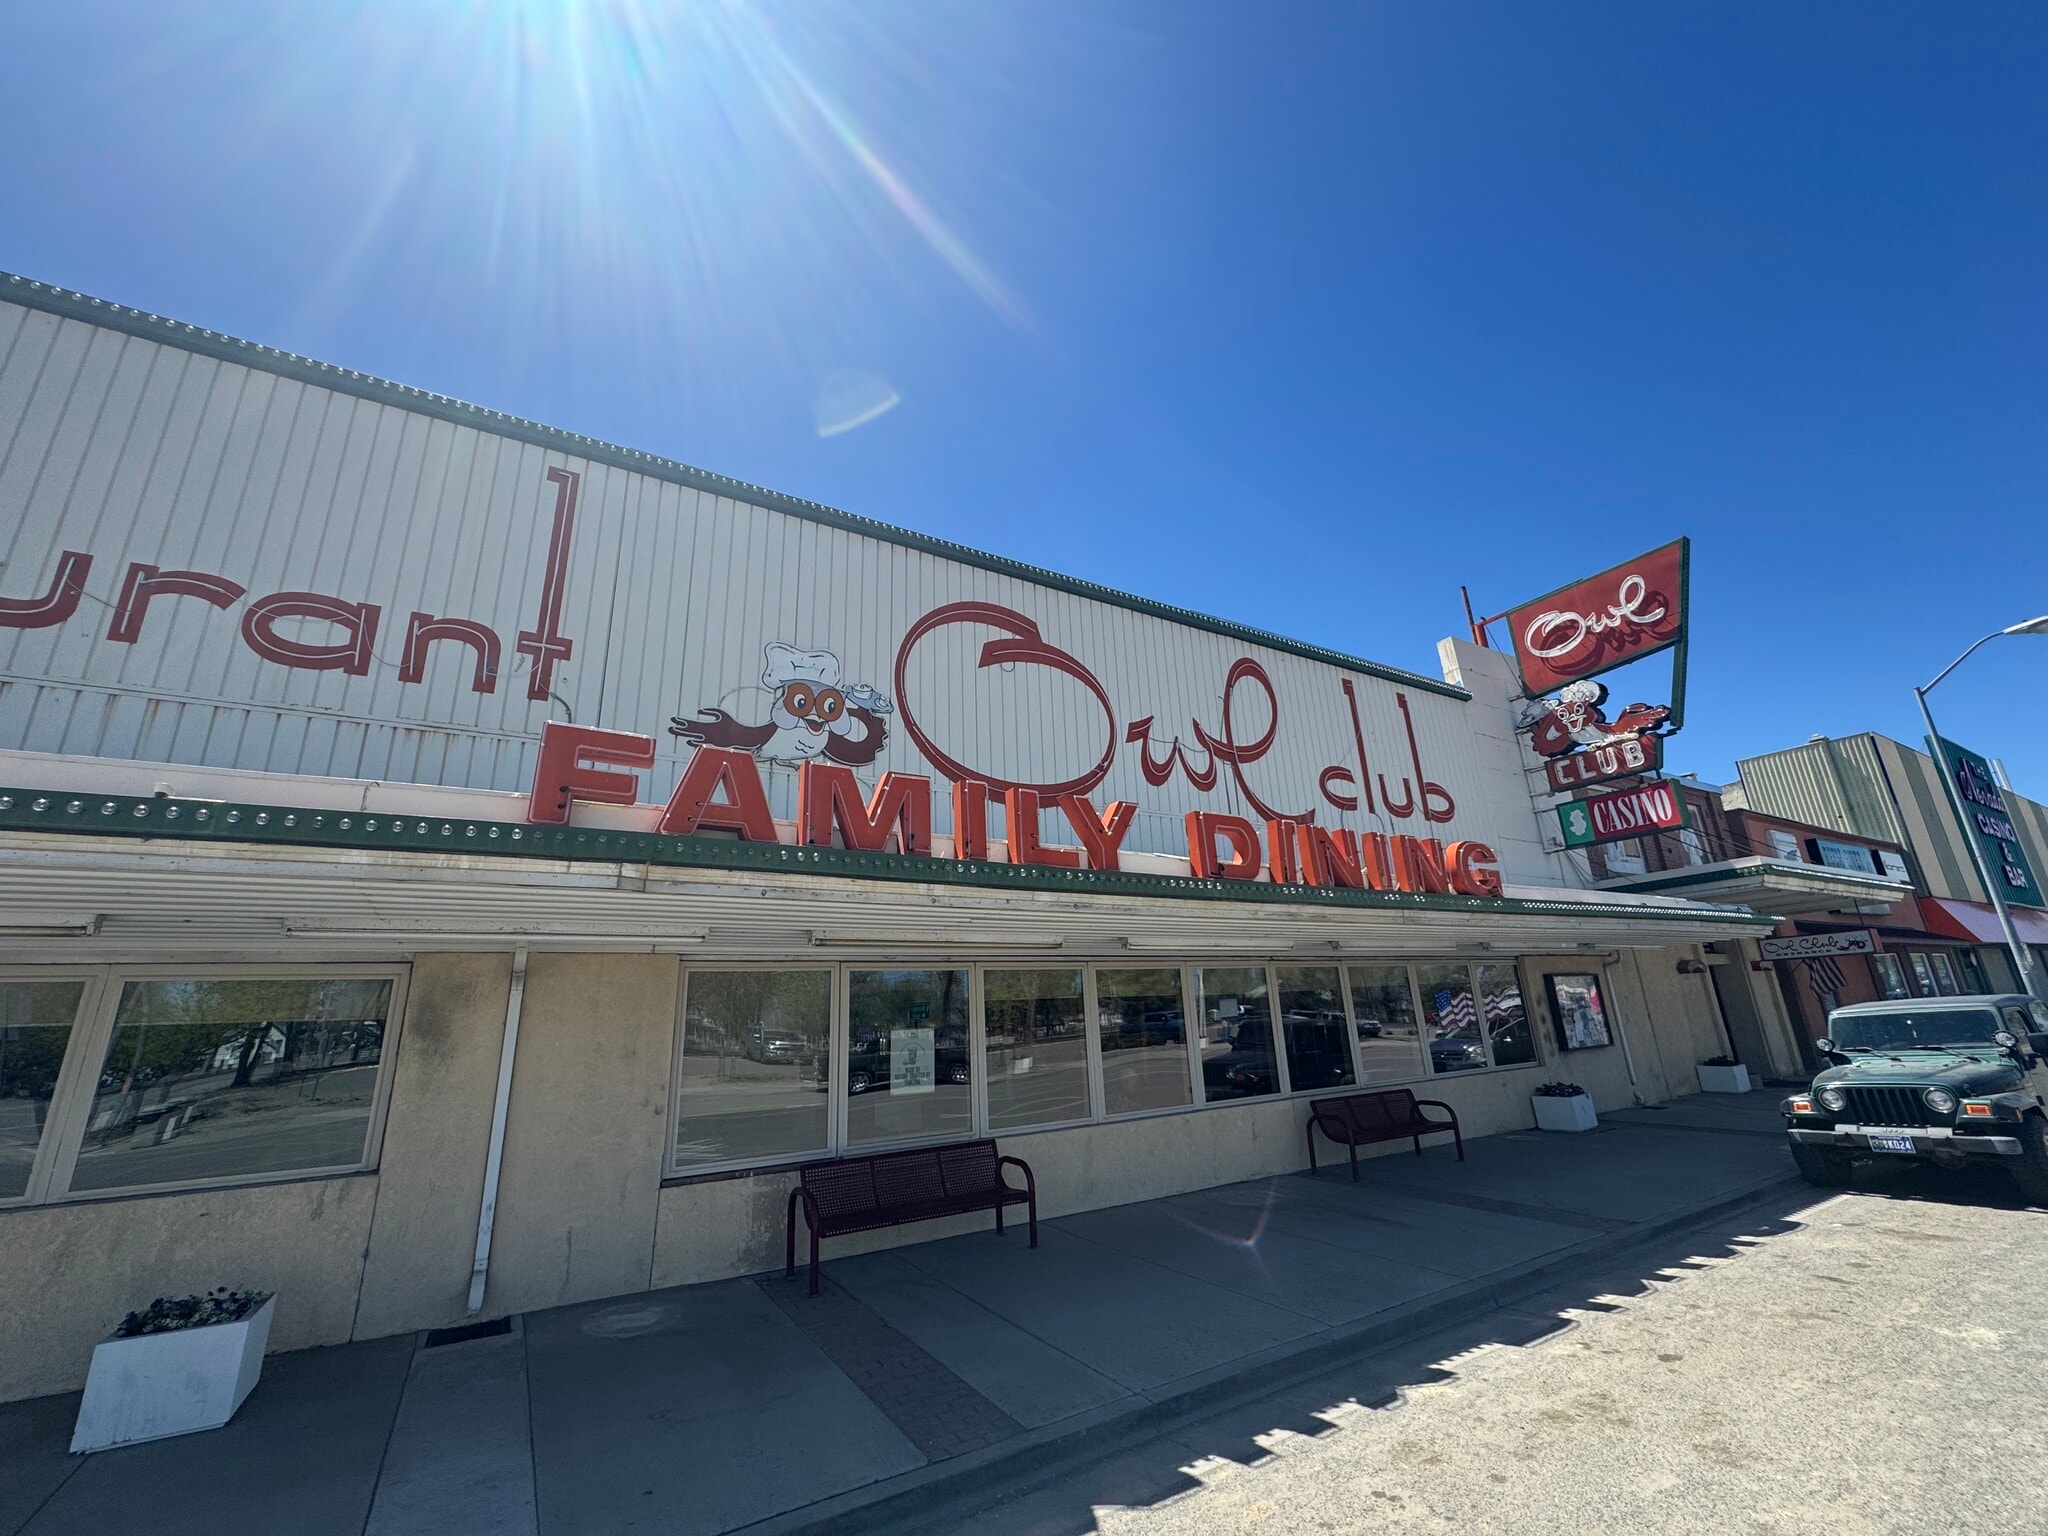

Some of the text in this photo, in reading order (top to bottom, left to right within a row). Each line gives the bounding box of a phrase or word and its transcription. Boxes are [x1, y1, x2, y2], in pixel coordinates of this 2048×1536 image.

[1525, 574, 1665, 657] Owl
[894, 601, 1456, 826] Owl club
[1553, 740, 1645, 785] CLUB
[527, 719, 1504, 897] FAMILY DINING
[1592, 787, 1673, 834] CASINO
[1976, 813, 2016, 843] CASINO
[2002, 842, 2014, 863] &
[2007, 865, 2029, 889] BAR
[1763, 935, 1839, 953] Owl Club
